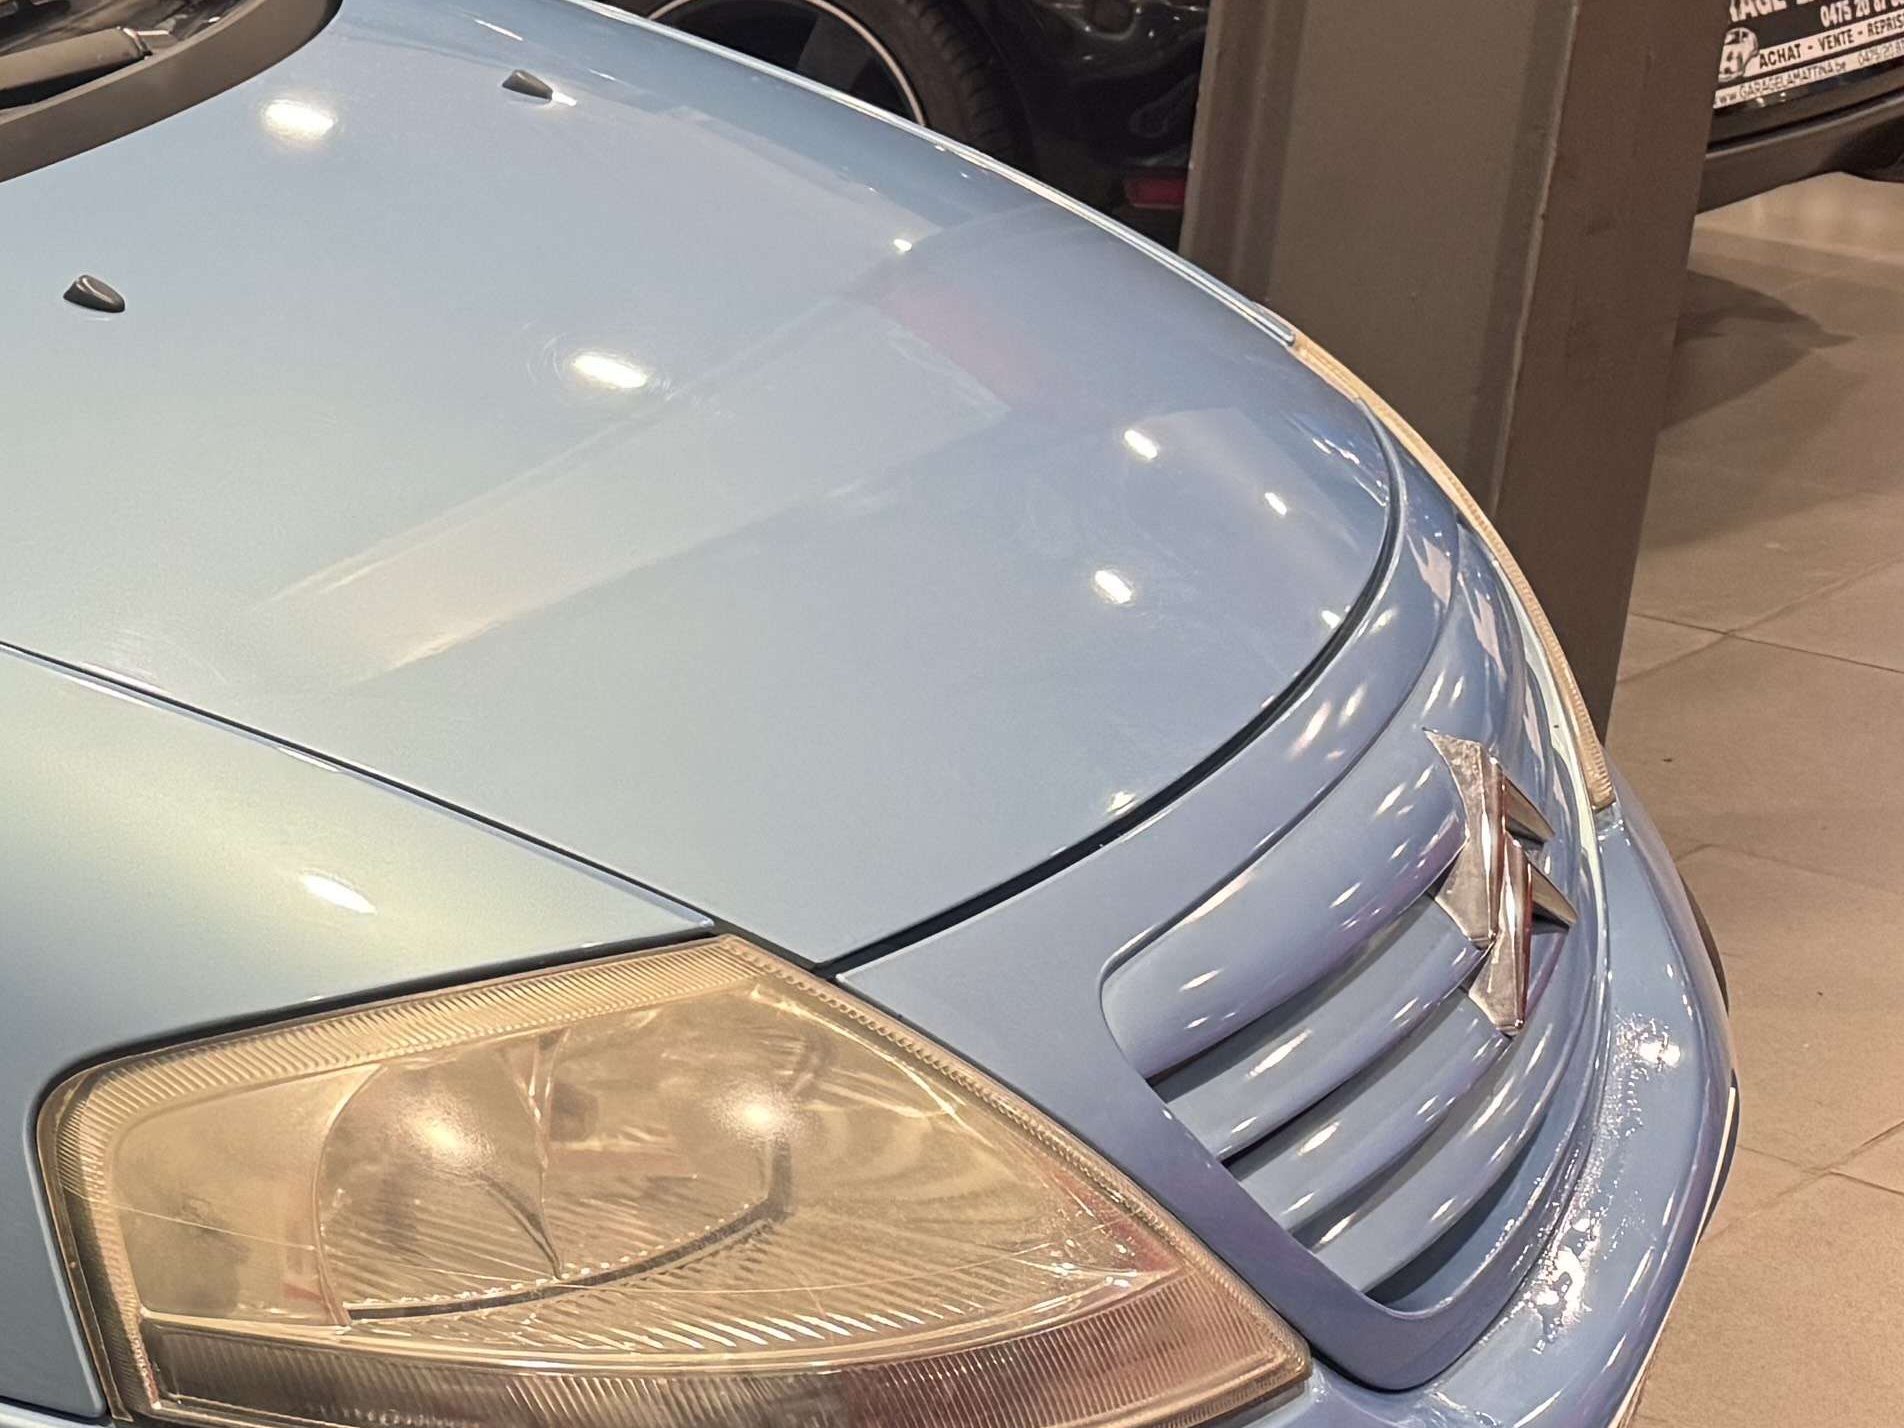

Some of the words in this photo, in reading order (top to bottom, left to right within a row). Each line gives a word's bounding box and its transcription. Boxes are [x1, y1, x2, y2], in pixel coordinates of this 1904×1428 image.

[1758, 43, 1803, 70] ACHAT
[1817, 28, 1855, 52] VENTE
[1866, 12, 1904, 37] REPRIS
